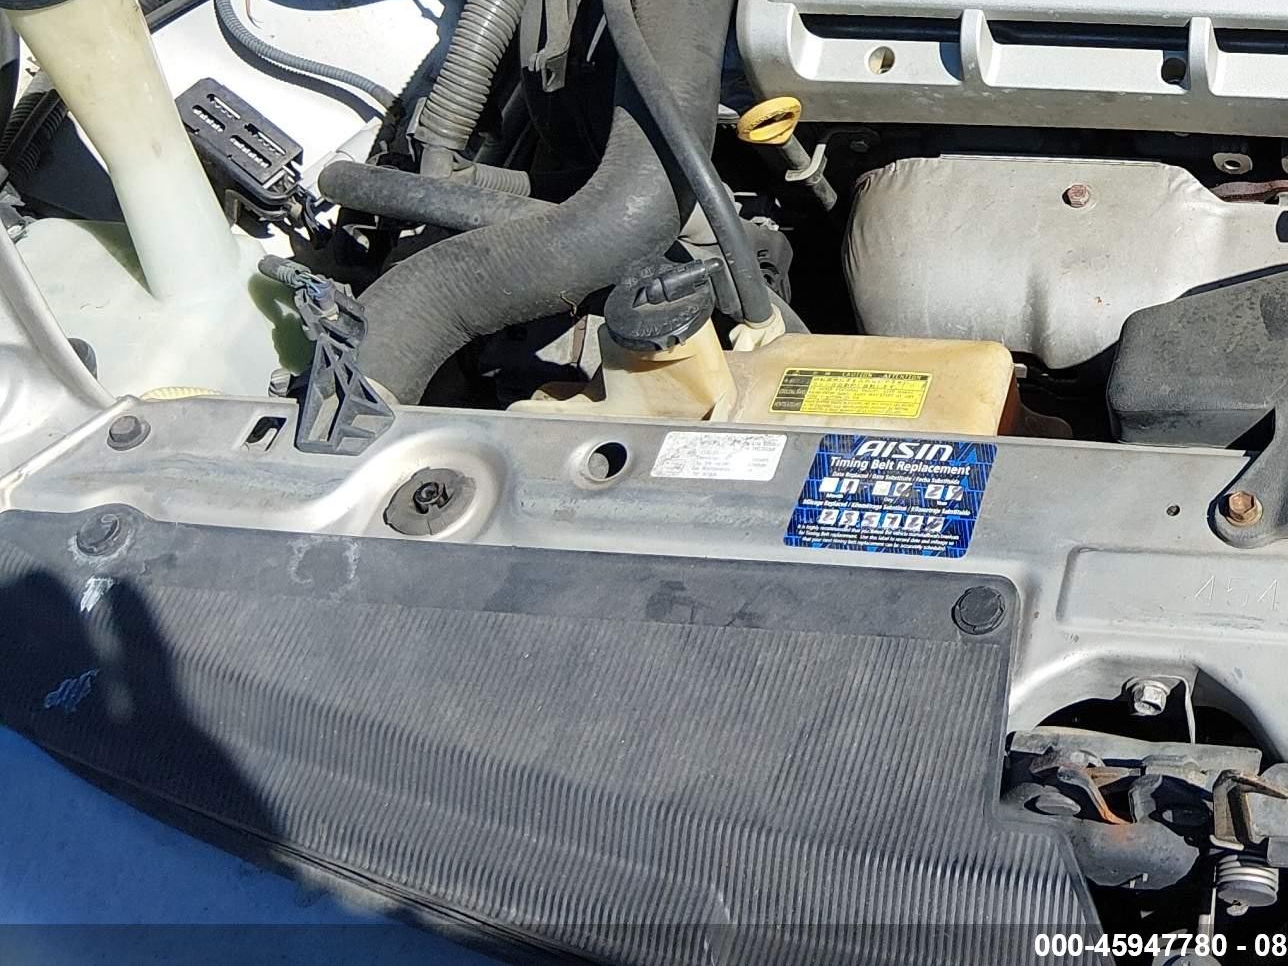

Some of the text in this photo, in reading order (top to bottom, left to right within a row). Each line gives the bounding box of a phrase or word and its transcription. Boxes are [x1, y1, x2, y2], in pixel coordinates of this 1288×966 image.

[854, 440, 954, 462] AISIN
[830, 456, 971, 476] Timing Belt Replacement
